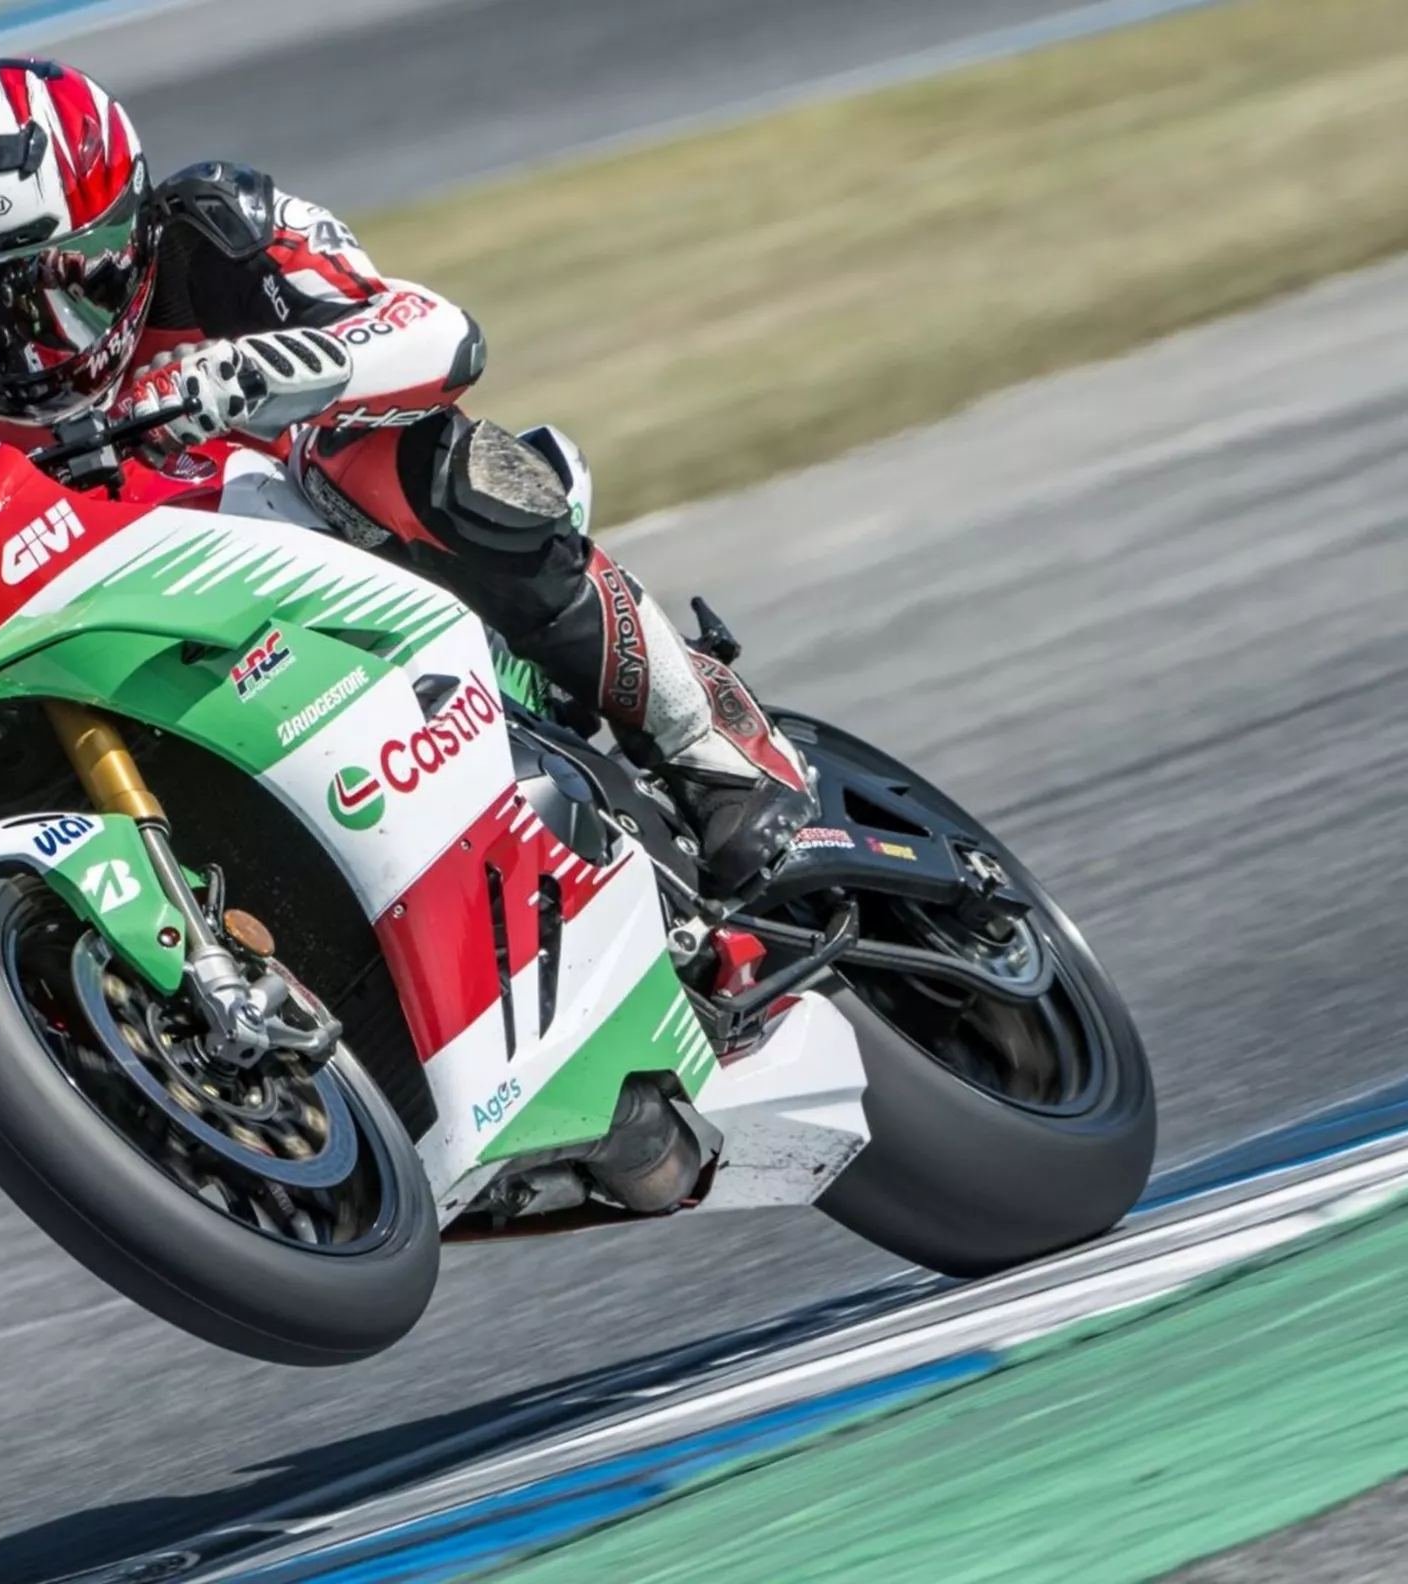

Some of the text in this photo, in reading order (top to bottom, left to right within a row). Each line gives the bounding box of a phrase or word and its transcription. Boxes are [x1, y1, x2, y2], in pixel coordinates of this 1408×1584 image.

[1, 498, 85, 585] GIVI
[230, 630, 291, 697] HRC
[600, 568, 646, 711] daytona
[277, 665, 369, 747] BRIDGESTONE
[380, 670, 502, 793] Castrol
[472, 1077, 522, 1133] Agos
